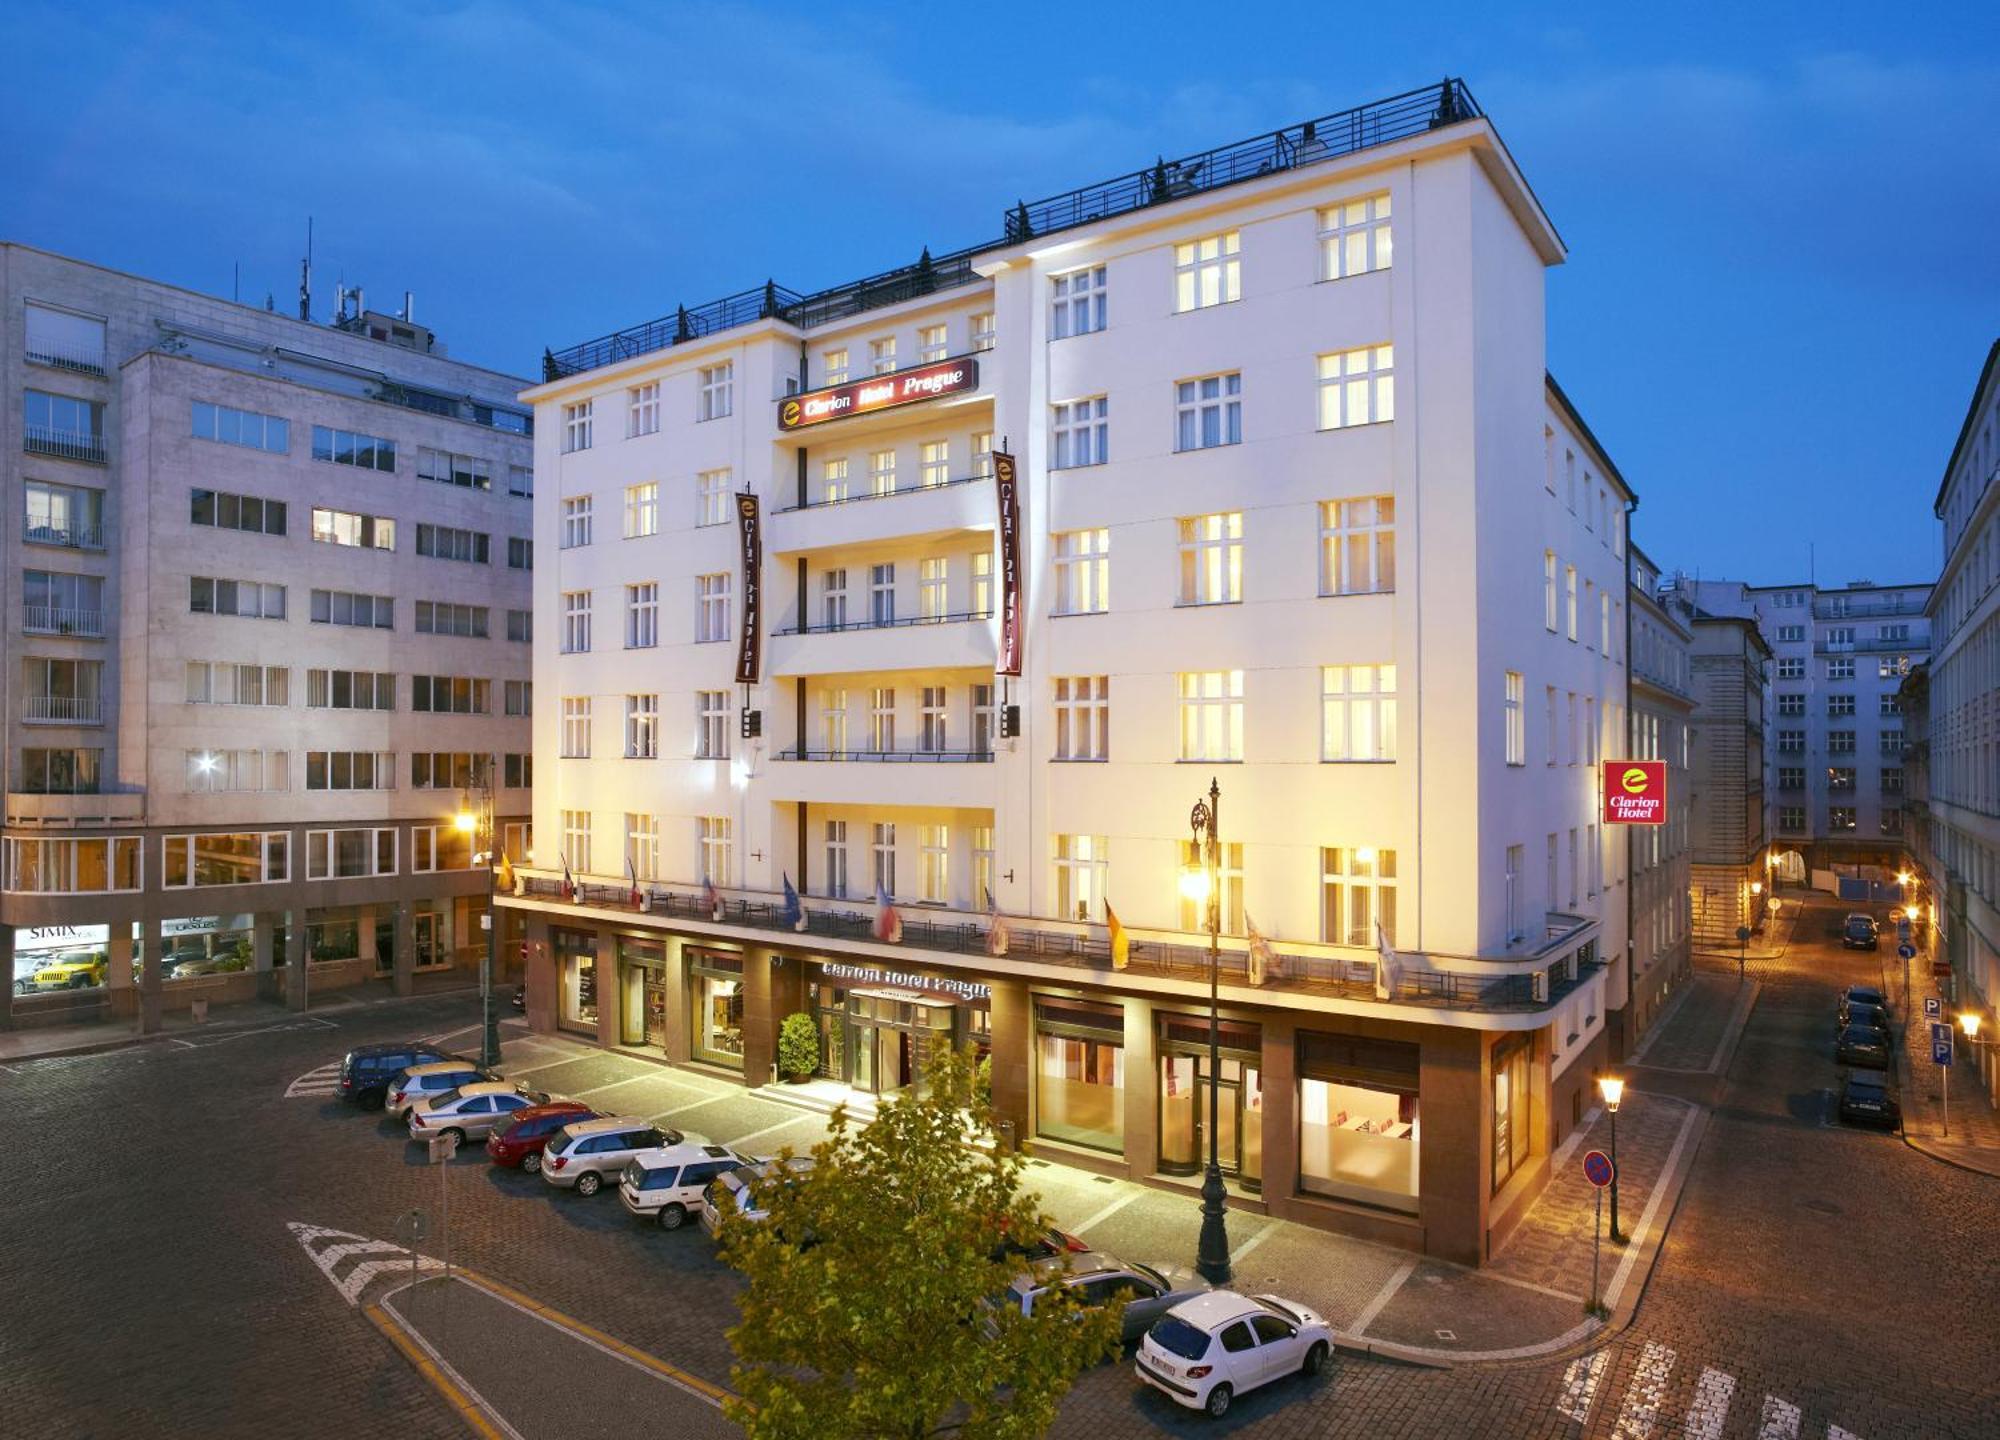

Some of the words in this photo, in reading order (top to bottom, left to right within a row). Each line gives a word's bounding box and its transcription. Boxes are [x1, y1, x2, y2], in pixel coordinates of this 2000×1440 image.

[804, 395, 851, 417] Clarion
[903, 370, 963, 395] Prague
[1610, 795, 1660, 808] Clarion
[1617, 807, 1652, 819] Hotel
[1927, 999, 1938, 1012] P
[1935, 1043, 1948, 1058] P
